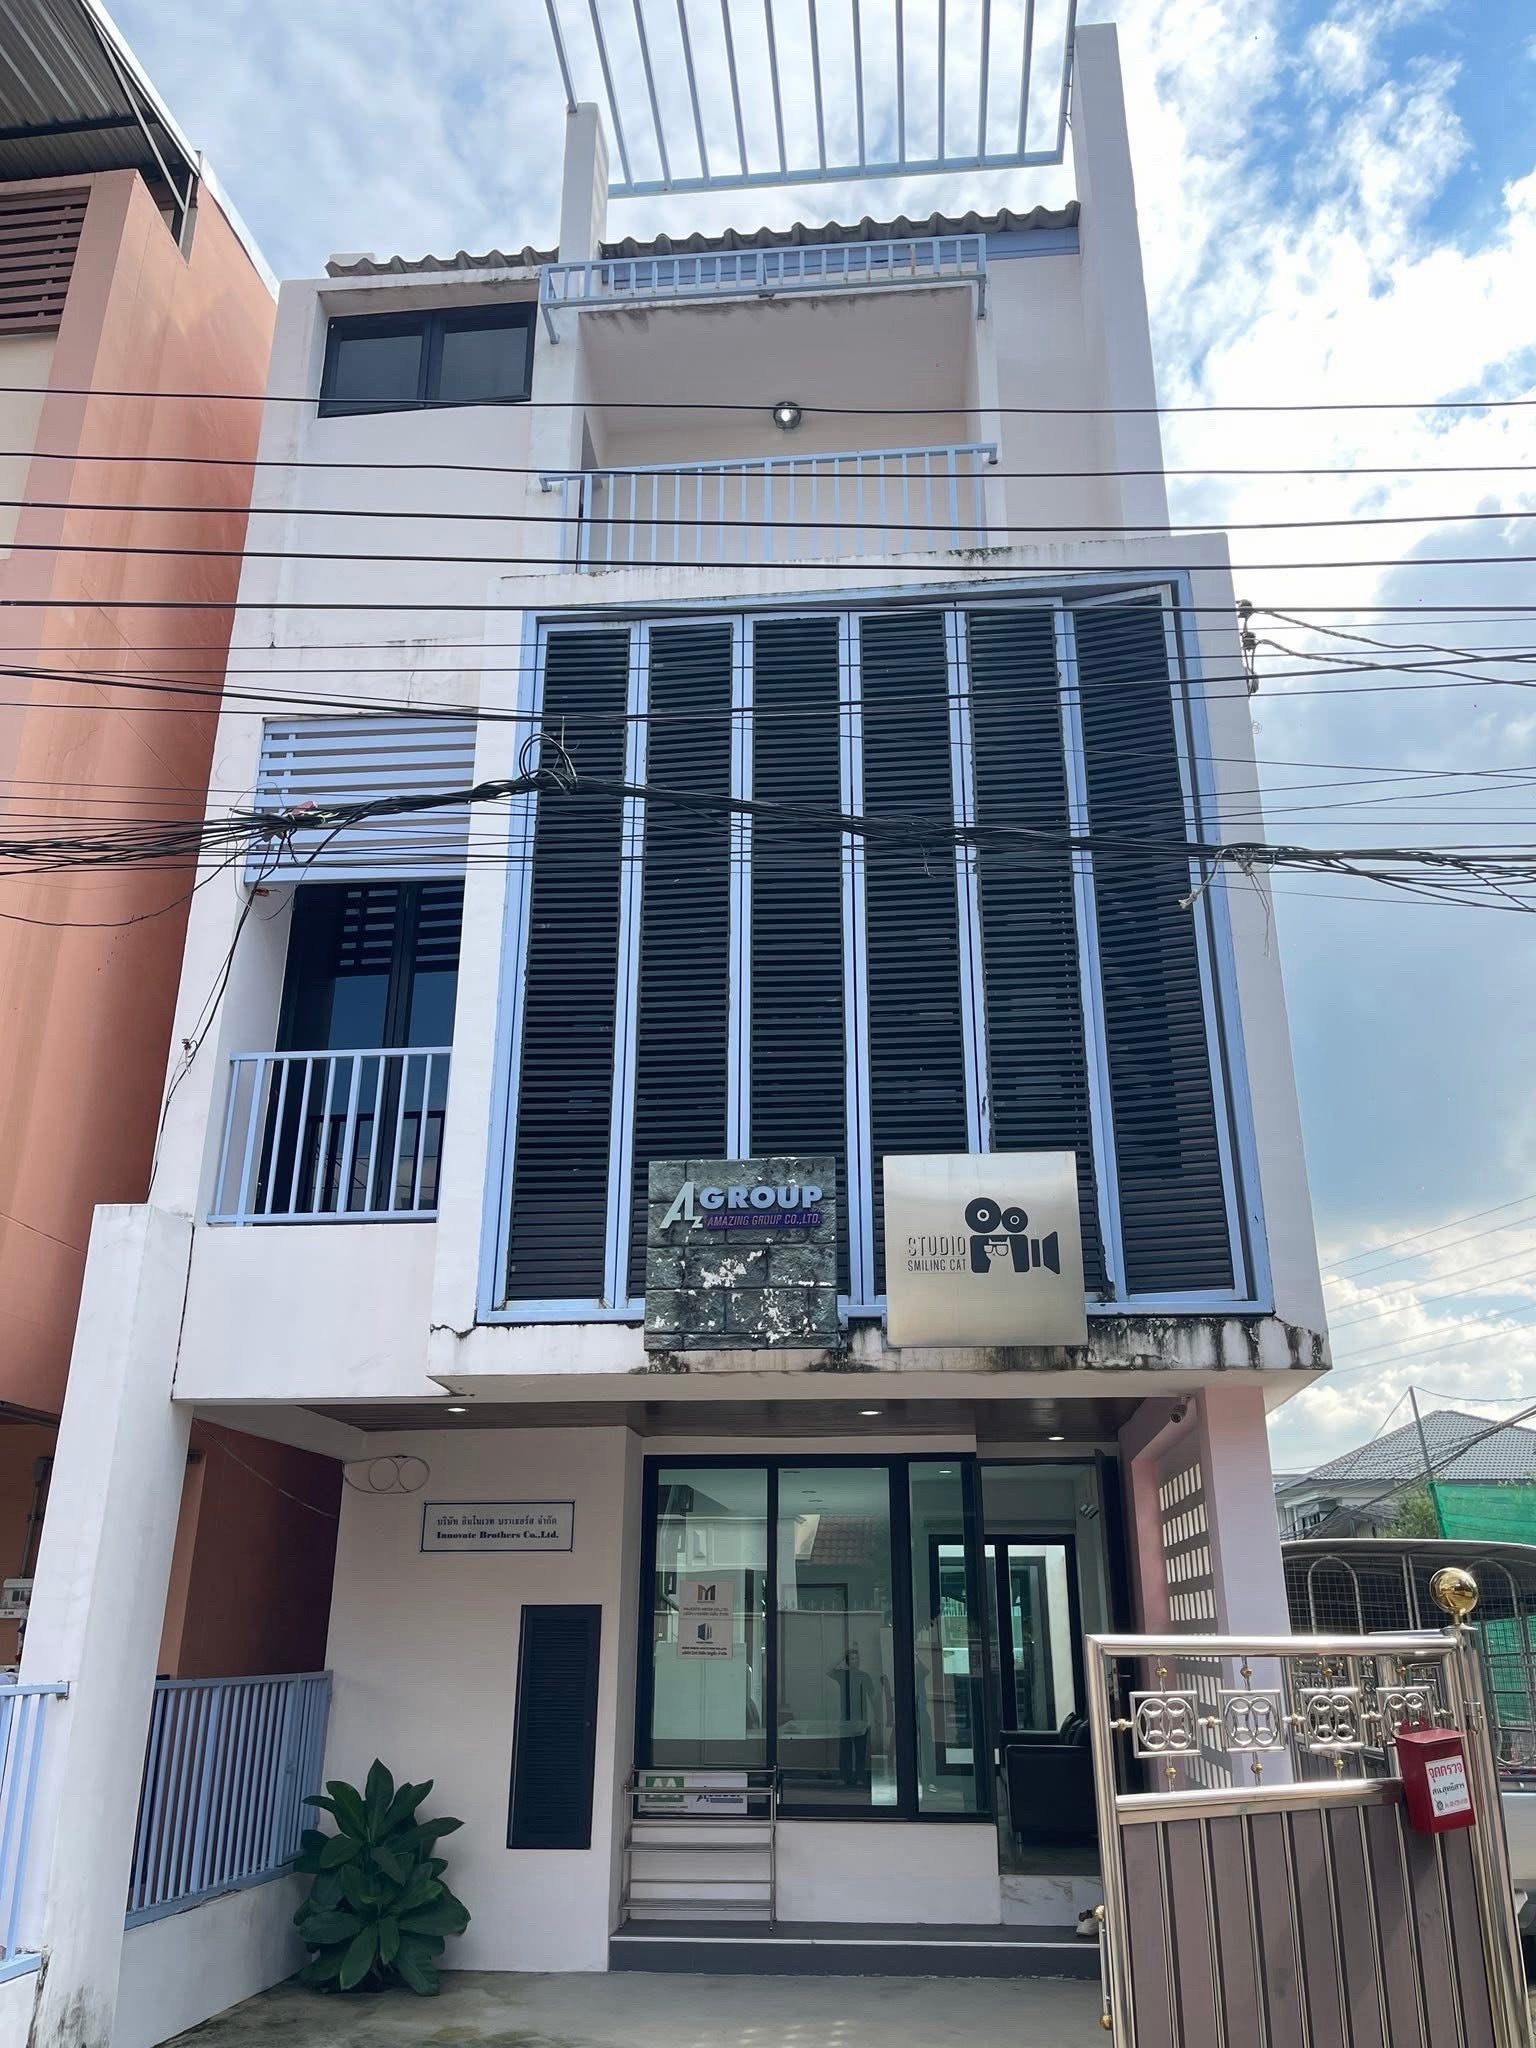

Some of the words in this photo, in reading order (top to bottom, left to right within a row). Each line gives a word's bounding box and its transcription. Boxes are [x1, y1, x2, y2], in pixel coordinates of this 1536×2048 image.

[700, 1185, 823, 1209] GROUP
[707, 1216, 749, 1227] AMAZING
[752, 1215, 782, 1225] GROUP
[784, 1213, 821, 1225] CO.,LTD.
[908, 1235, 966, 1257] STUDIO
[907, 1259, 946, 1272] SMILING
[949, 1258, 967, 1271] CAT
[437, 1515, 459, 1526] บริษัท
[537, 1515, 558, 1525] จำกัด
[437, 1531, 477, 1539] Innovate
[479, 1530, 521, 1539] Brothers
[523, 1530, 560, 1539] Co.,Ltd.
[1429, 1762, 1463, 1783] จุดตรวจ
